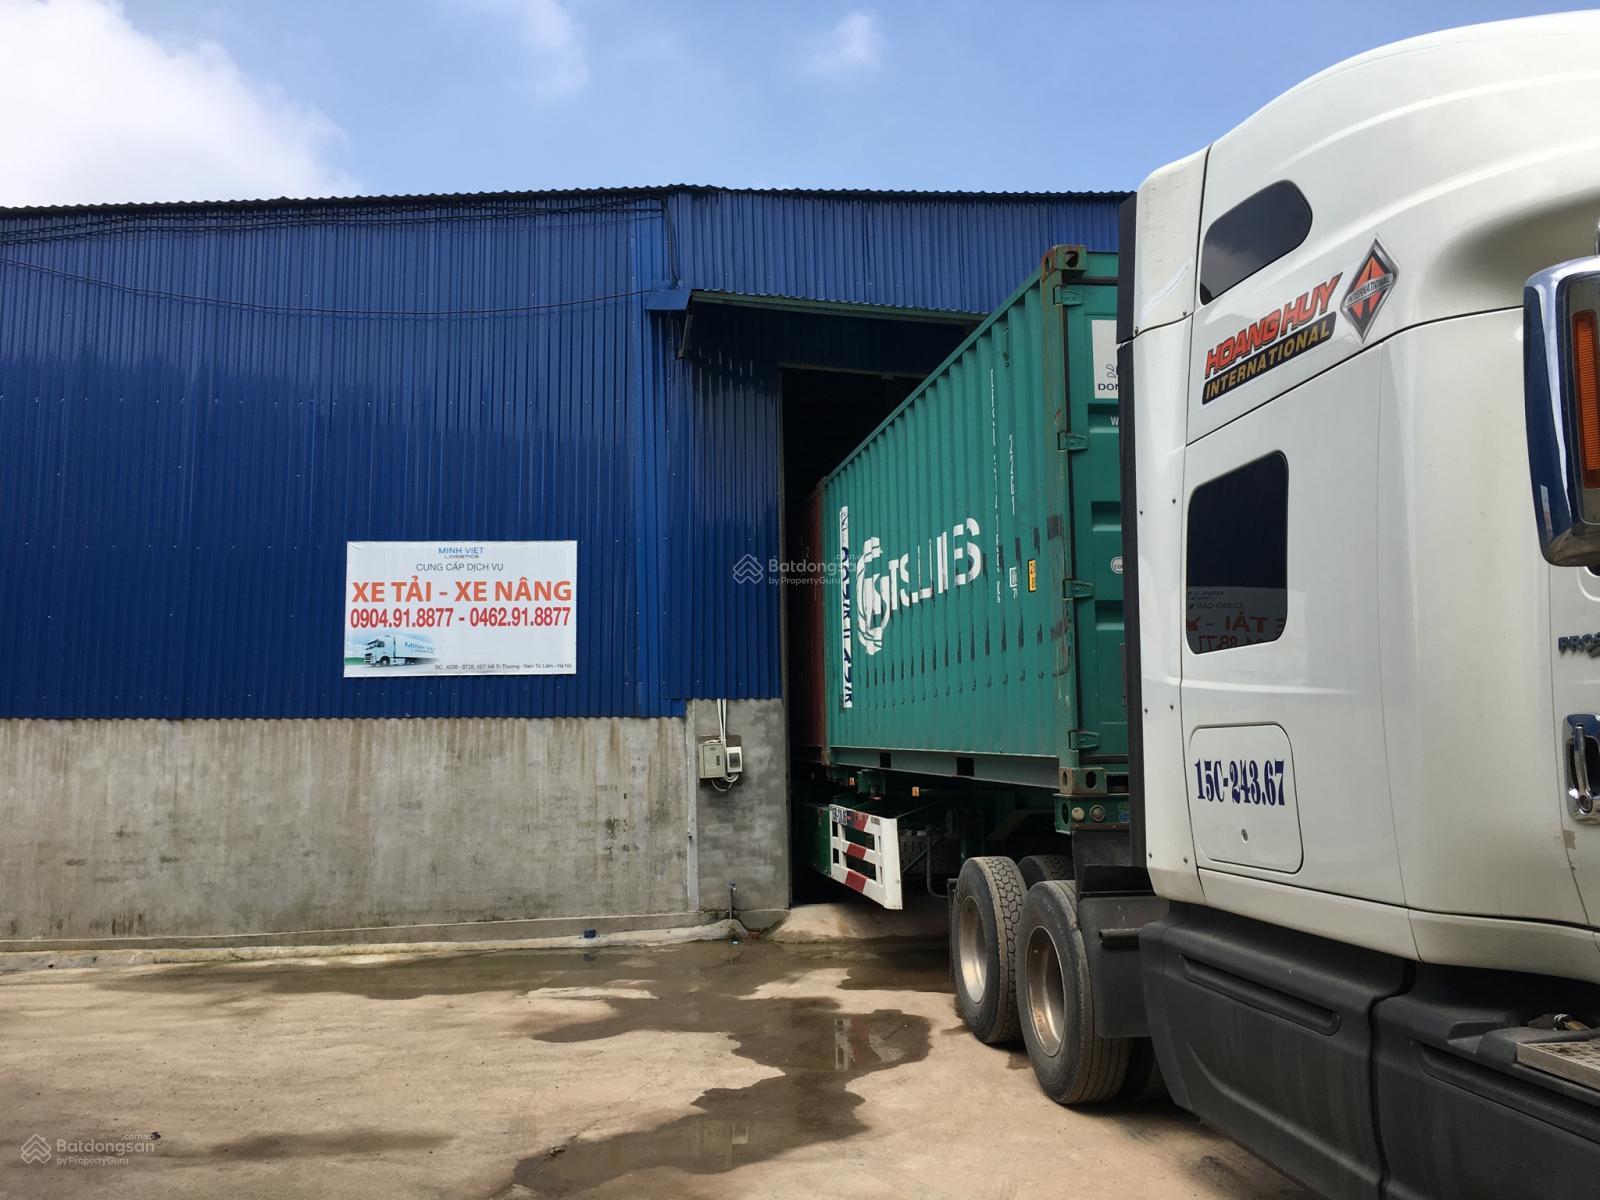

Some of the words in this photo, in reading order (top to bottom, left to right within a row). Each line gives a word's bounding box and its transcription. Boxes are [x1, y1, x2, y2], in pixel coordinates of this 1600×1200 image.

[1347, 276, 1391, 304] INTERNATIONAL
[1204, 308, 1282, 380] HOANG
[1280, 272, 1343, 336] HUY
[1205, 321, 1330, 398] INTERNATIONAL
[438, 546, 463, 554] MINH
[416, 563, 444, 572] CUNG
[445, 560, 465, 572] CẤP
[467, 563, 489, 573] DỊCH
[491, 563, 504, 573] VỤ
[351, 581, 385, 603] XE
[391, 575, 432, 602] TẢI
[454, 581, 488, 602] XE
[495, 576, 572, 602] NÂNG
[350, 607, 454, 628] 0904.91.8877
[470, 606, 571, 627] 0462.91.8877
[1194, 757, 1286, 806] 15C-243.67
